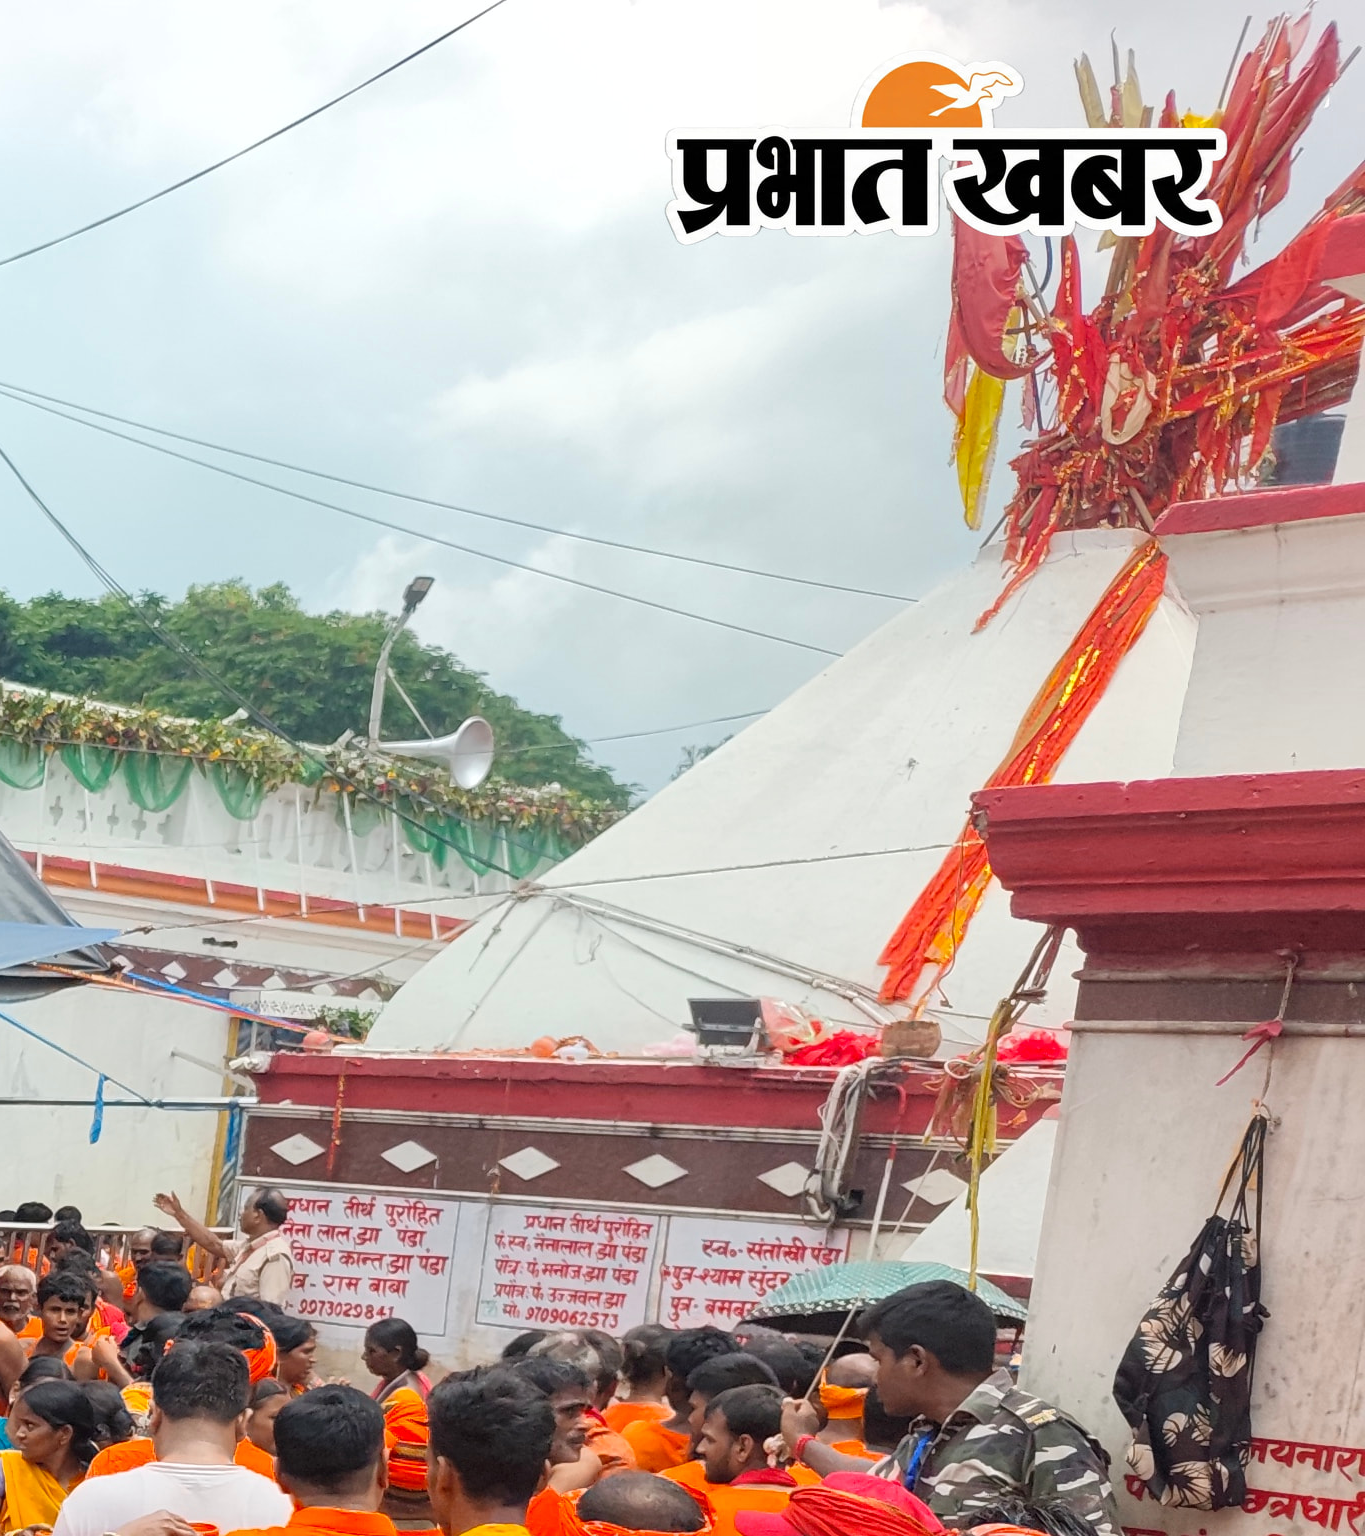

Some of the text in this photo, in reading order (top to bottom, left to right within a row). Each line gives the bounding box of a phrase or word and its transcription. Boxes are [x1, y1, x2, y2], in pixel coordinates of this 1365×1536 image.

[286, 1195, 444, 1228] प्रधान तीर्थ पुरोहित
[316, 1223, 353, 1244] लाल
[355, 1227, 382, 1247] झा
[396, 1225, 427, 1248] पंडा
[523, 1212, 653, 1243] प्रधान तीर्थ पुरोहित
[291, 1240, 449, 1276] विजय कान्त झा पंडा
[534, 1233, 594, 1258] नैनालाल
[595, 1241, 618, 1261] झा
[621, 1240, 648, 1263] पंडा
[809, 1241, 843, 1266] पंडा
[541, 1259, 583, 1283] मनोज
[584, 1265, 607, 1285] झा
[612, 1263, 639, 1286] पंडा
[323, 1275, 362, 1296] राम
[368, 1277, 409, 1299] बाबा
[297, 1298, 396, 1319] 9973029841
[603, 1291, 627, 1310] झा
[525, 1306, 619, 1329] 9709062573
